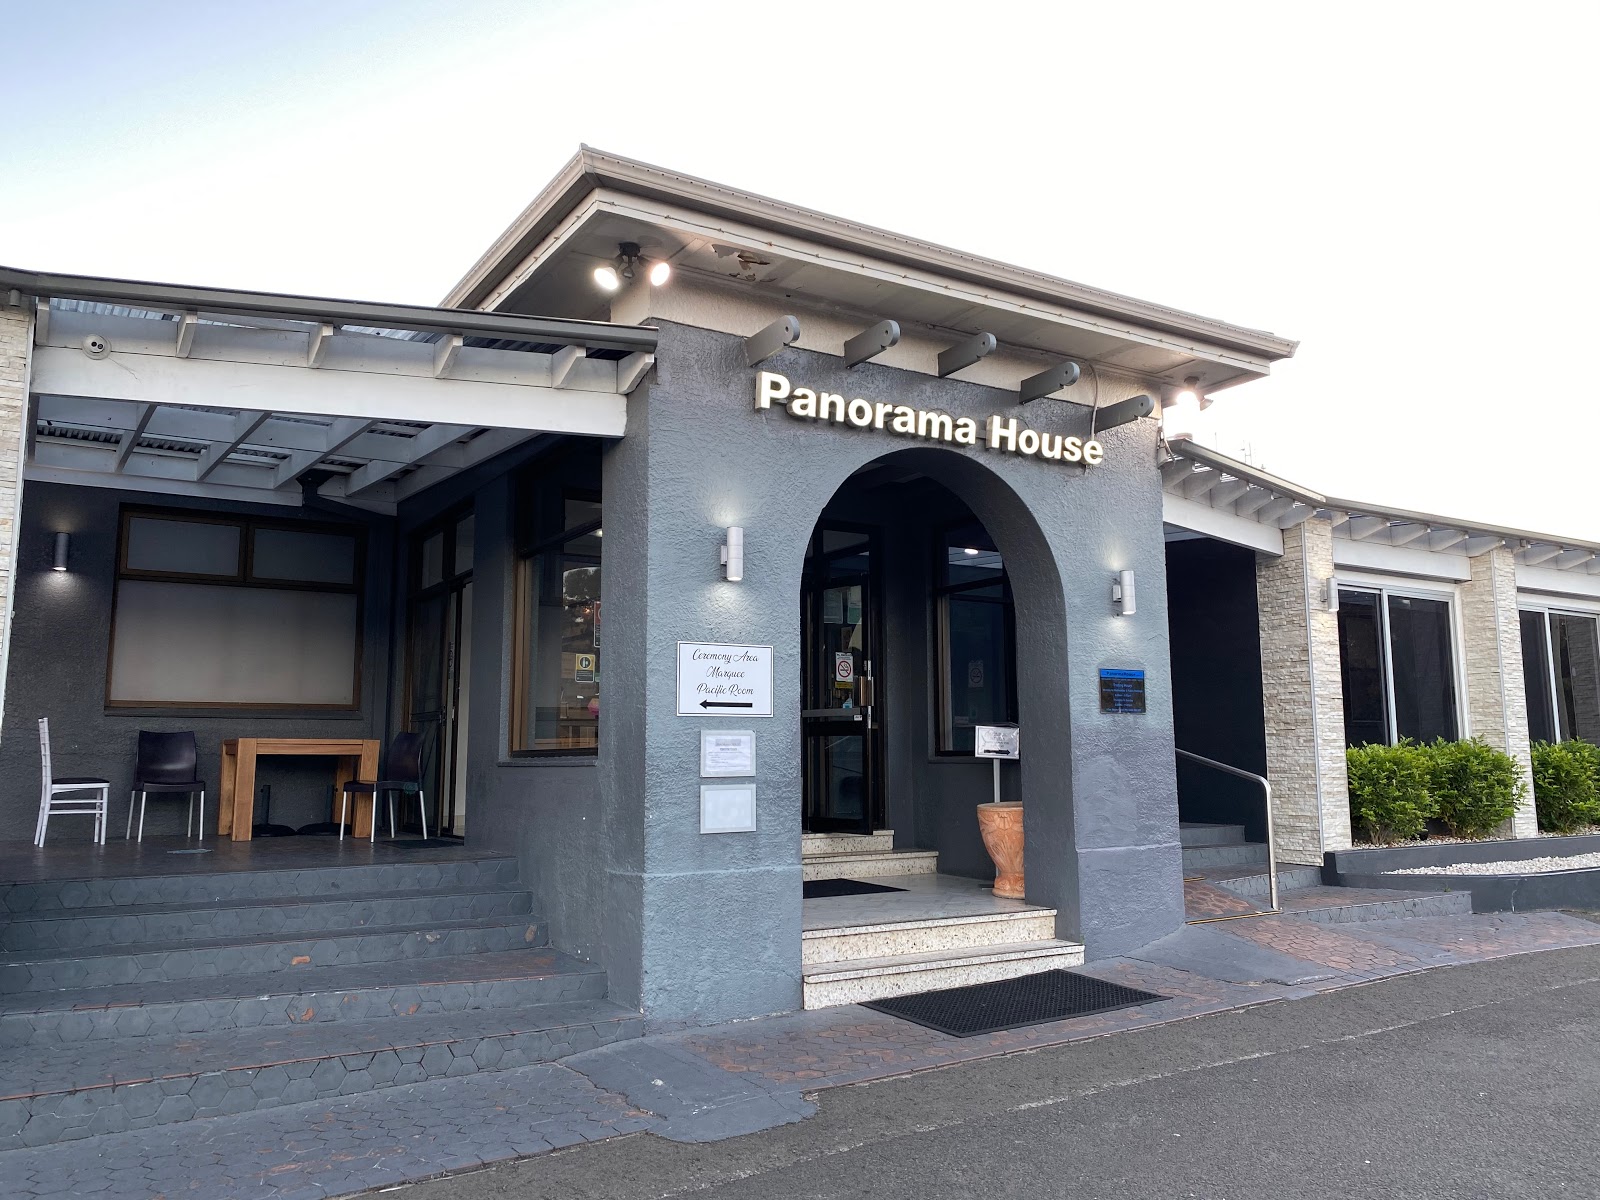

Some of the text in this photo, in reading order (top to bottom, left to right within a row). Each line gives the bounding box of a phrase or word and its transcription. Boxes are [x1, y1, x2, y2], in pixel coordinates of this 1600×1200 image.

[755, 371, 1105, 466] Panorama House
[692, 649, 759, 664] Ceremony Area
[706, 666, 745, 679] Marquee
[696, 682, 754, 697] Pacific Room
